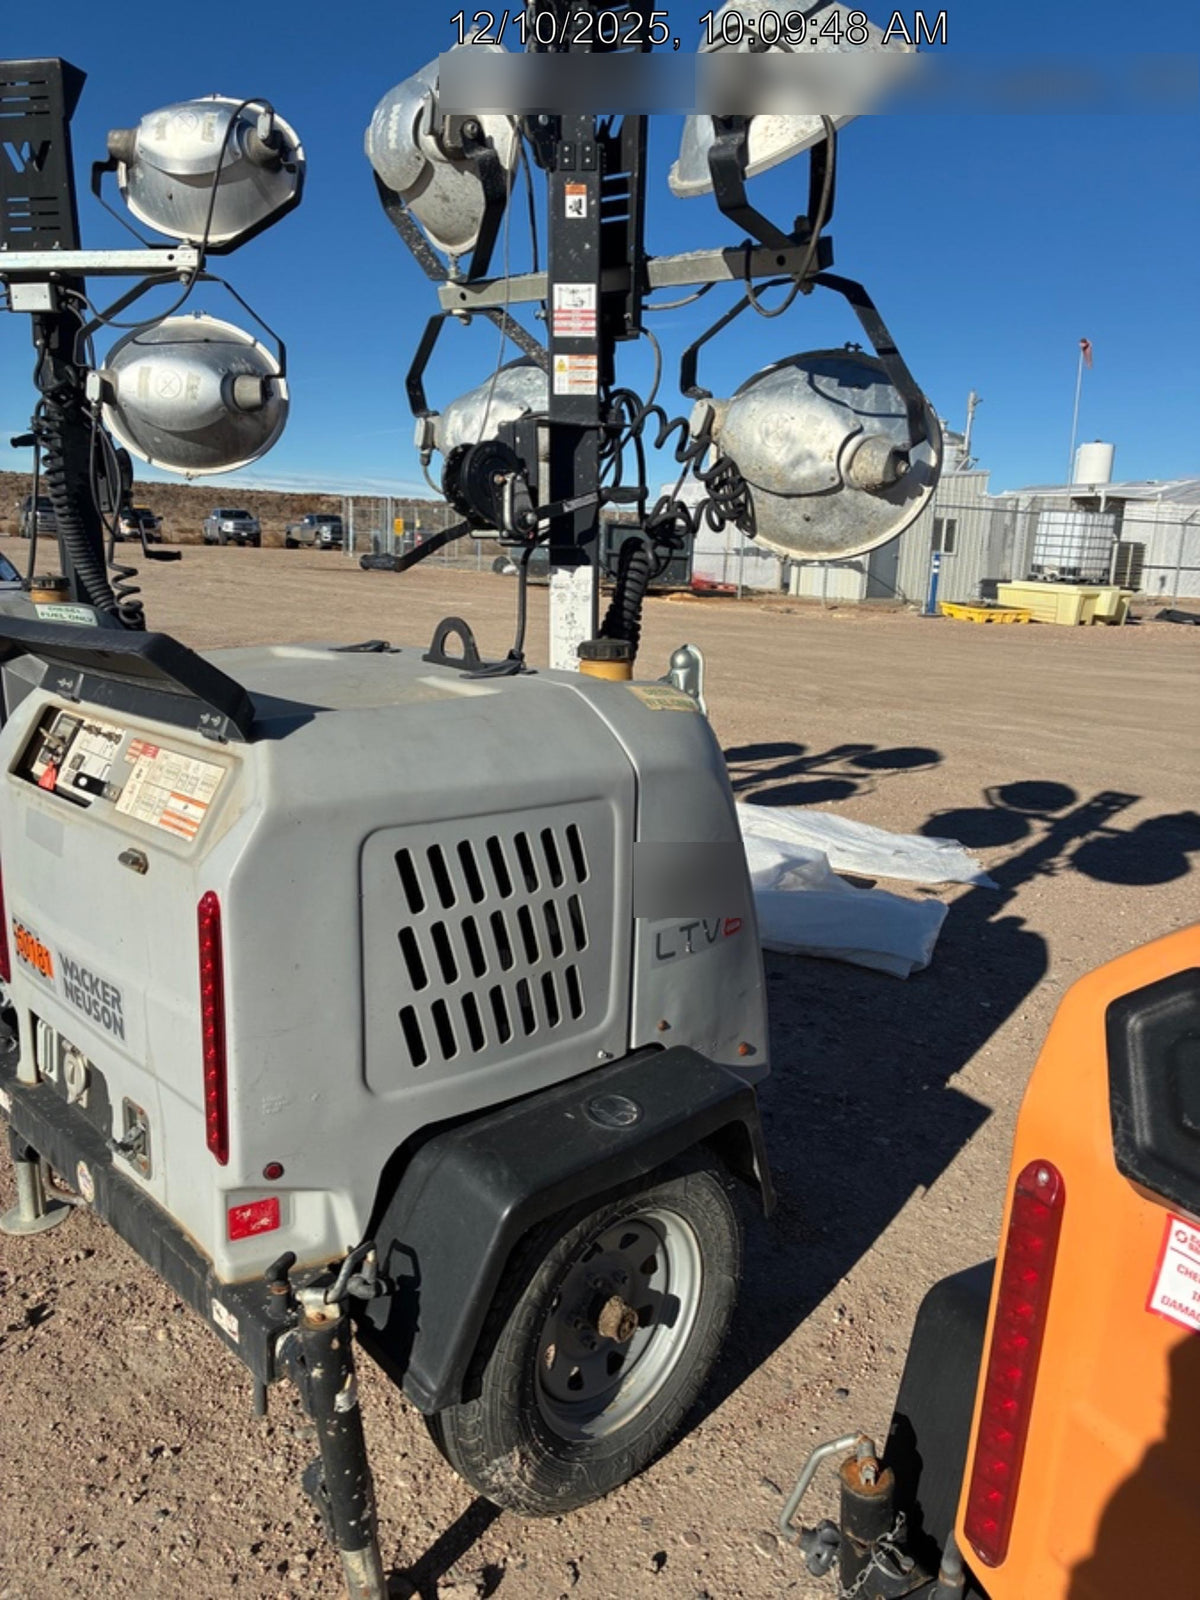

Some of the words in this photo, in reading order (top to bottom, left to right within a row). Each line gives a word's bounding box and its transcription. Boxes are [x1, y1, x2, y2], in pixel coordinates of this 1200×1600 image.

[58, 952, 124, 1015] WACKER
[63, 977, 125, 1041] NEUSON
[1177, 1263, 1200, 1284] CHE
